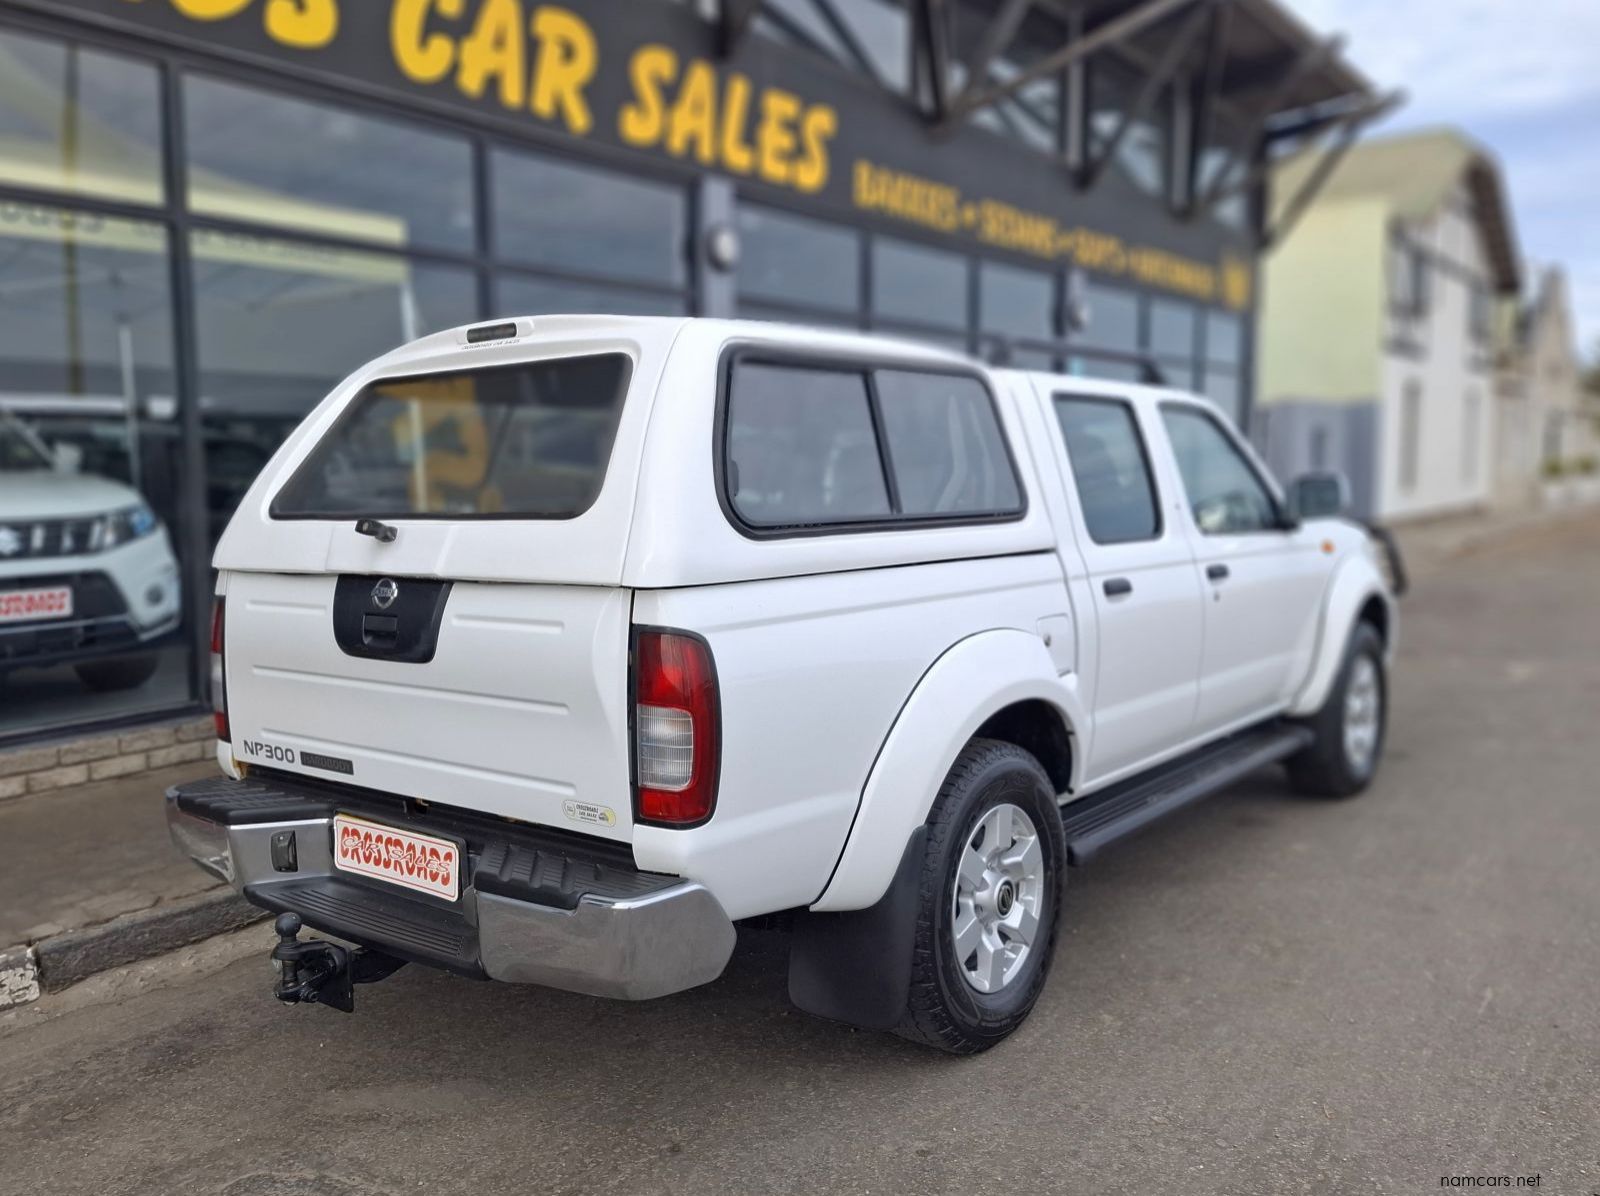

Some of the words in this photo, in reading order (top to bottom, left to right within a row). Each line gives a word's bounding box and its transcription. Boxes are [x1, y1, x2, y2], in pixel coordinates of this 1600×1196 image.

[391, 0, 597, 134] CAR
[620, 45, 837, 192] SALES
[244, 740, 295, 763] NP300
[341, 826, 452, 886] CROSSROADS
